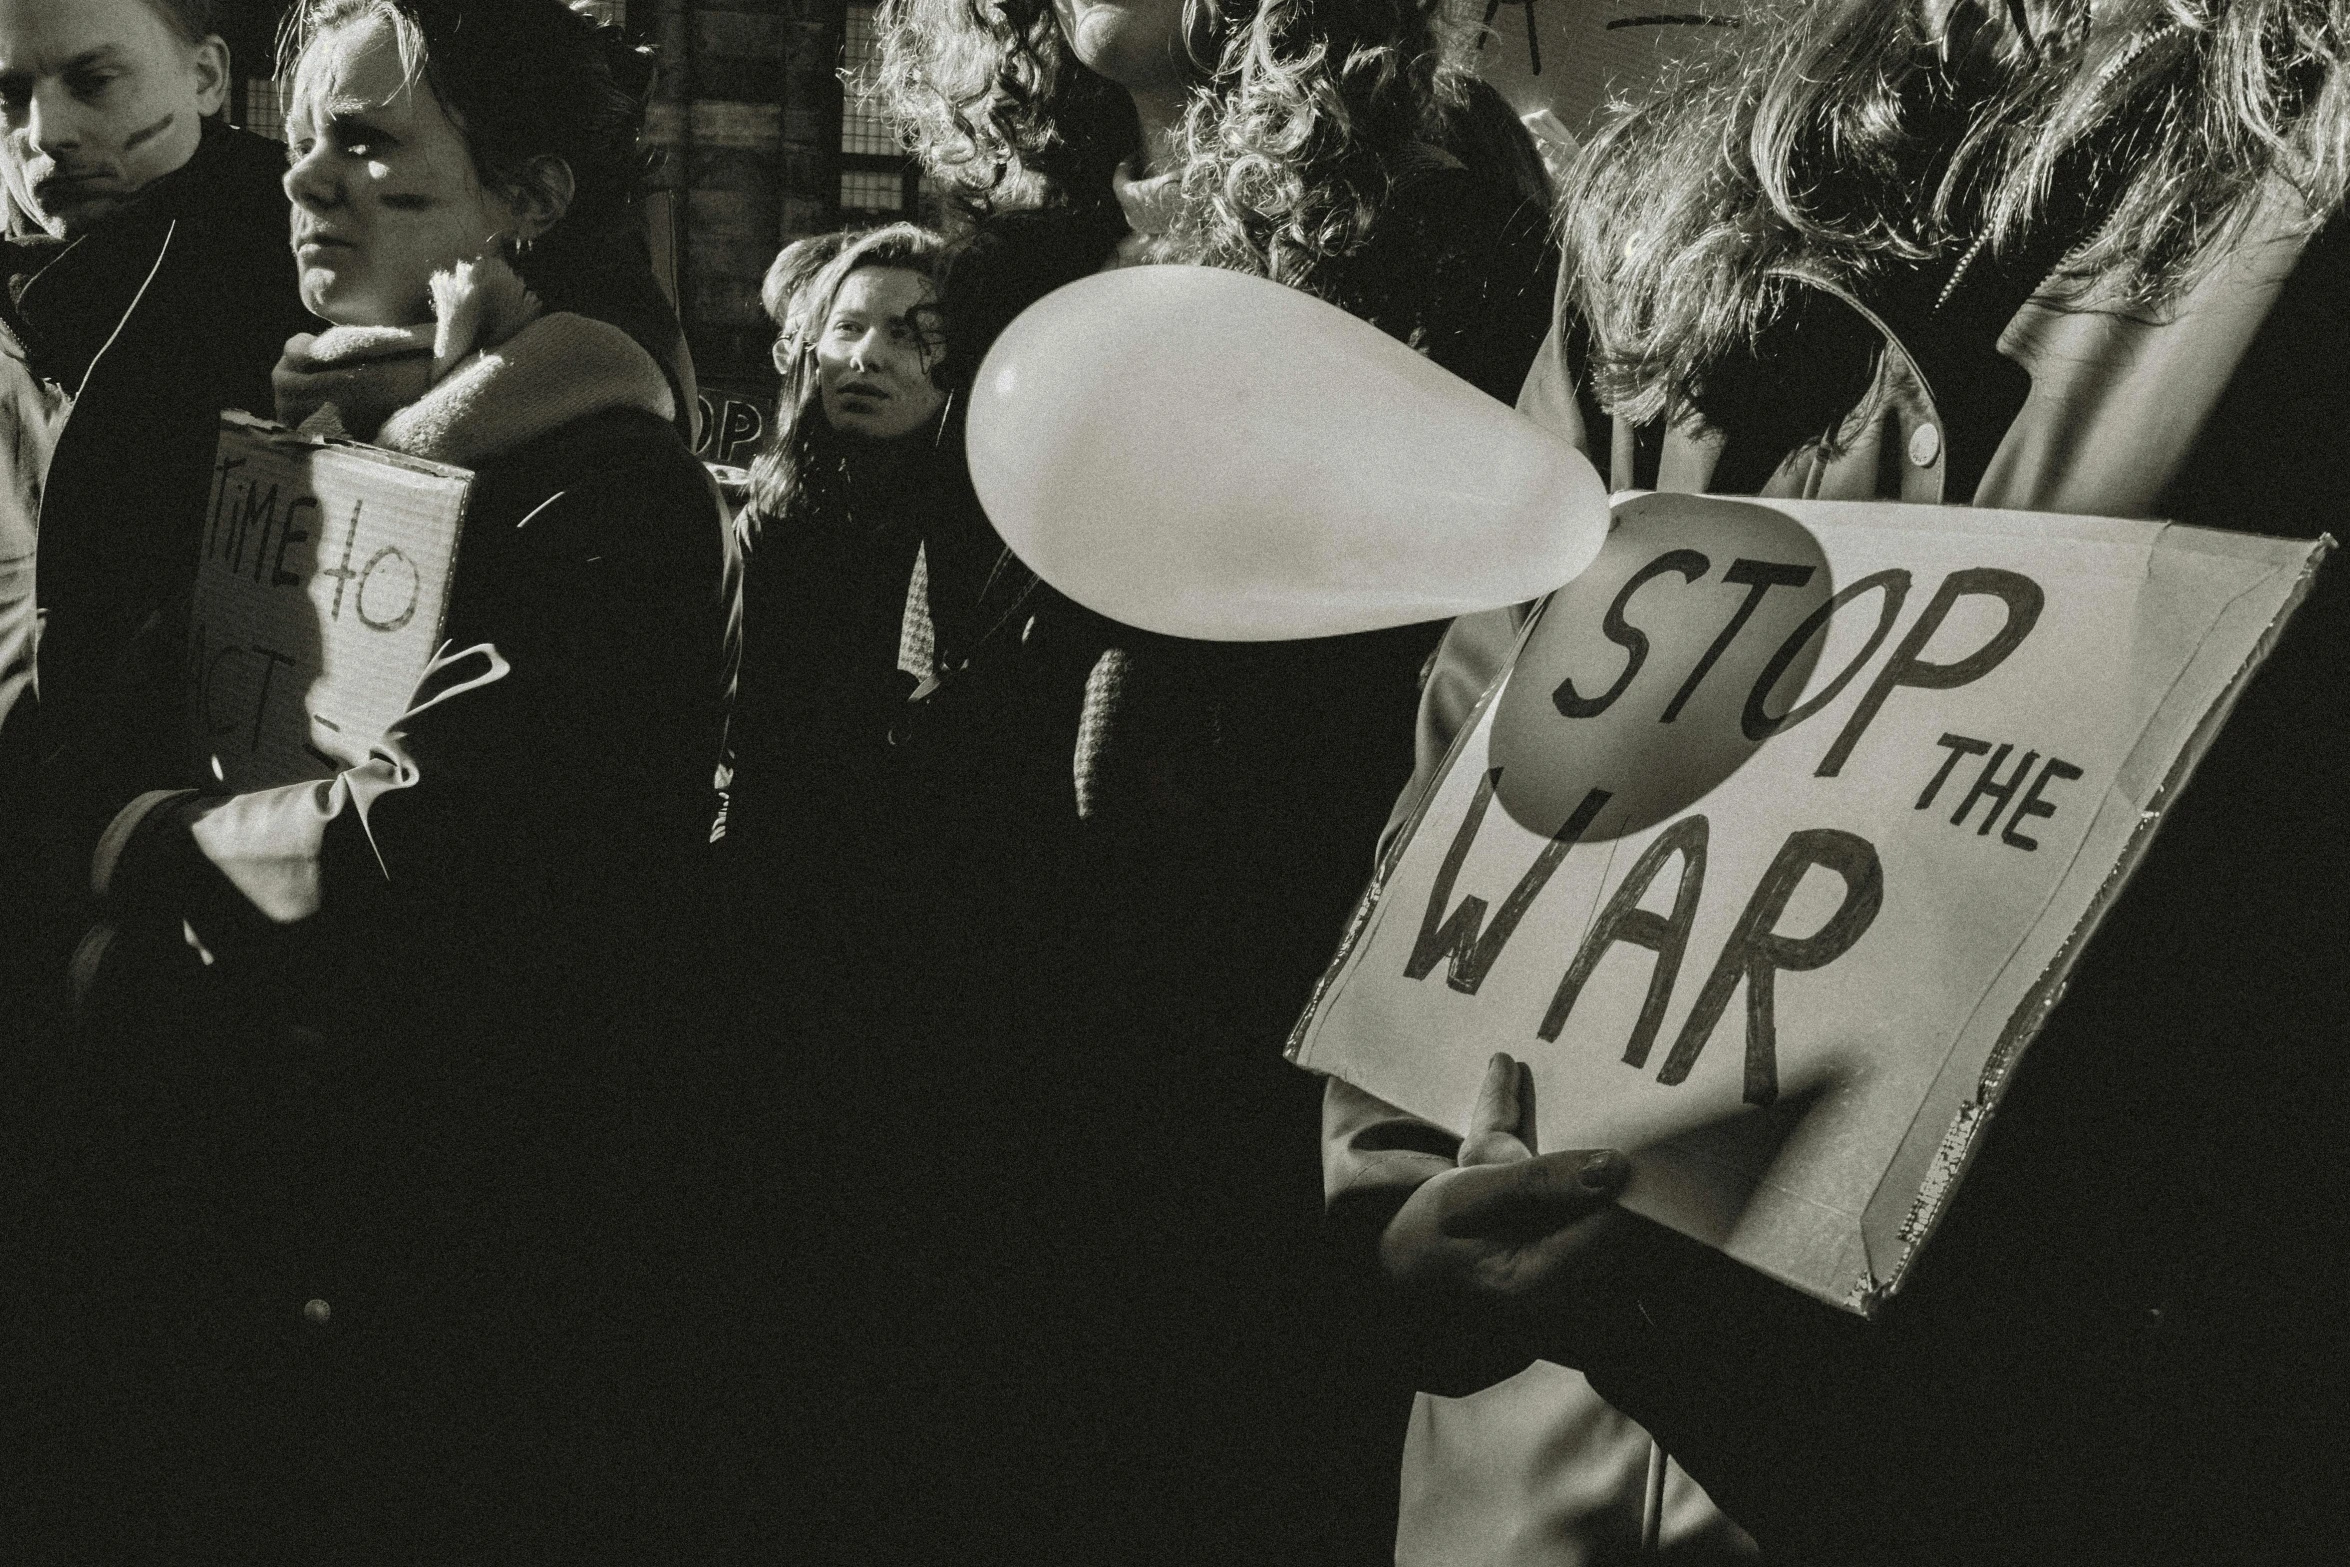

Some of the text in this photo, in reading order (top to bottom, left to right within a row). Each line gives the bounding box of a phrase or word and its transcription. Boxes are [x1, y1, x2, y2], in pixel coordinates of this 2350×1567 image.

[1552, 548, 2045, 778] STOP
[1914, 731, 2084, 852] THE
[1403, 766, 1885, 1104] WAR
